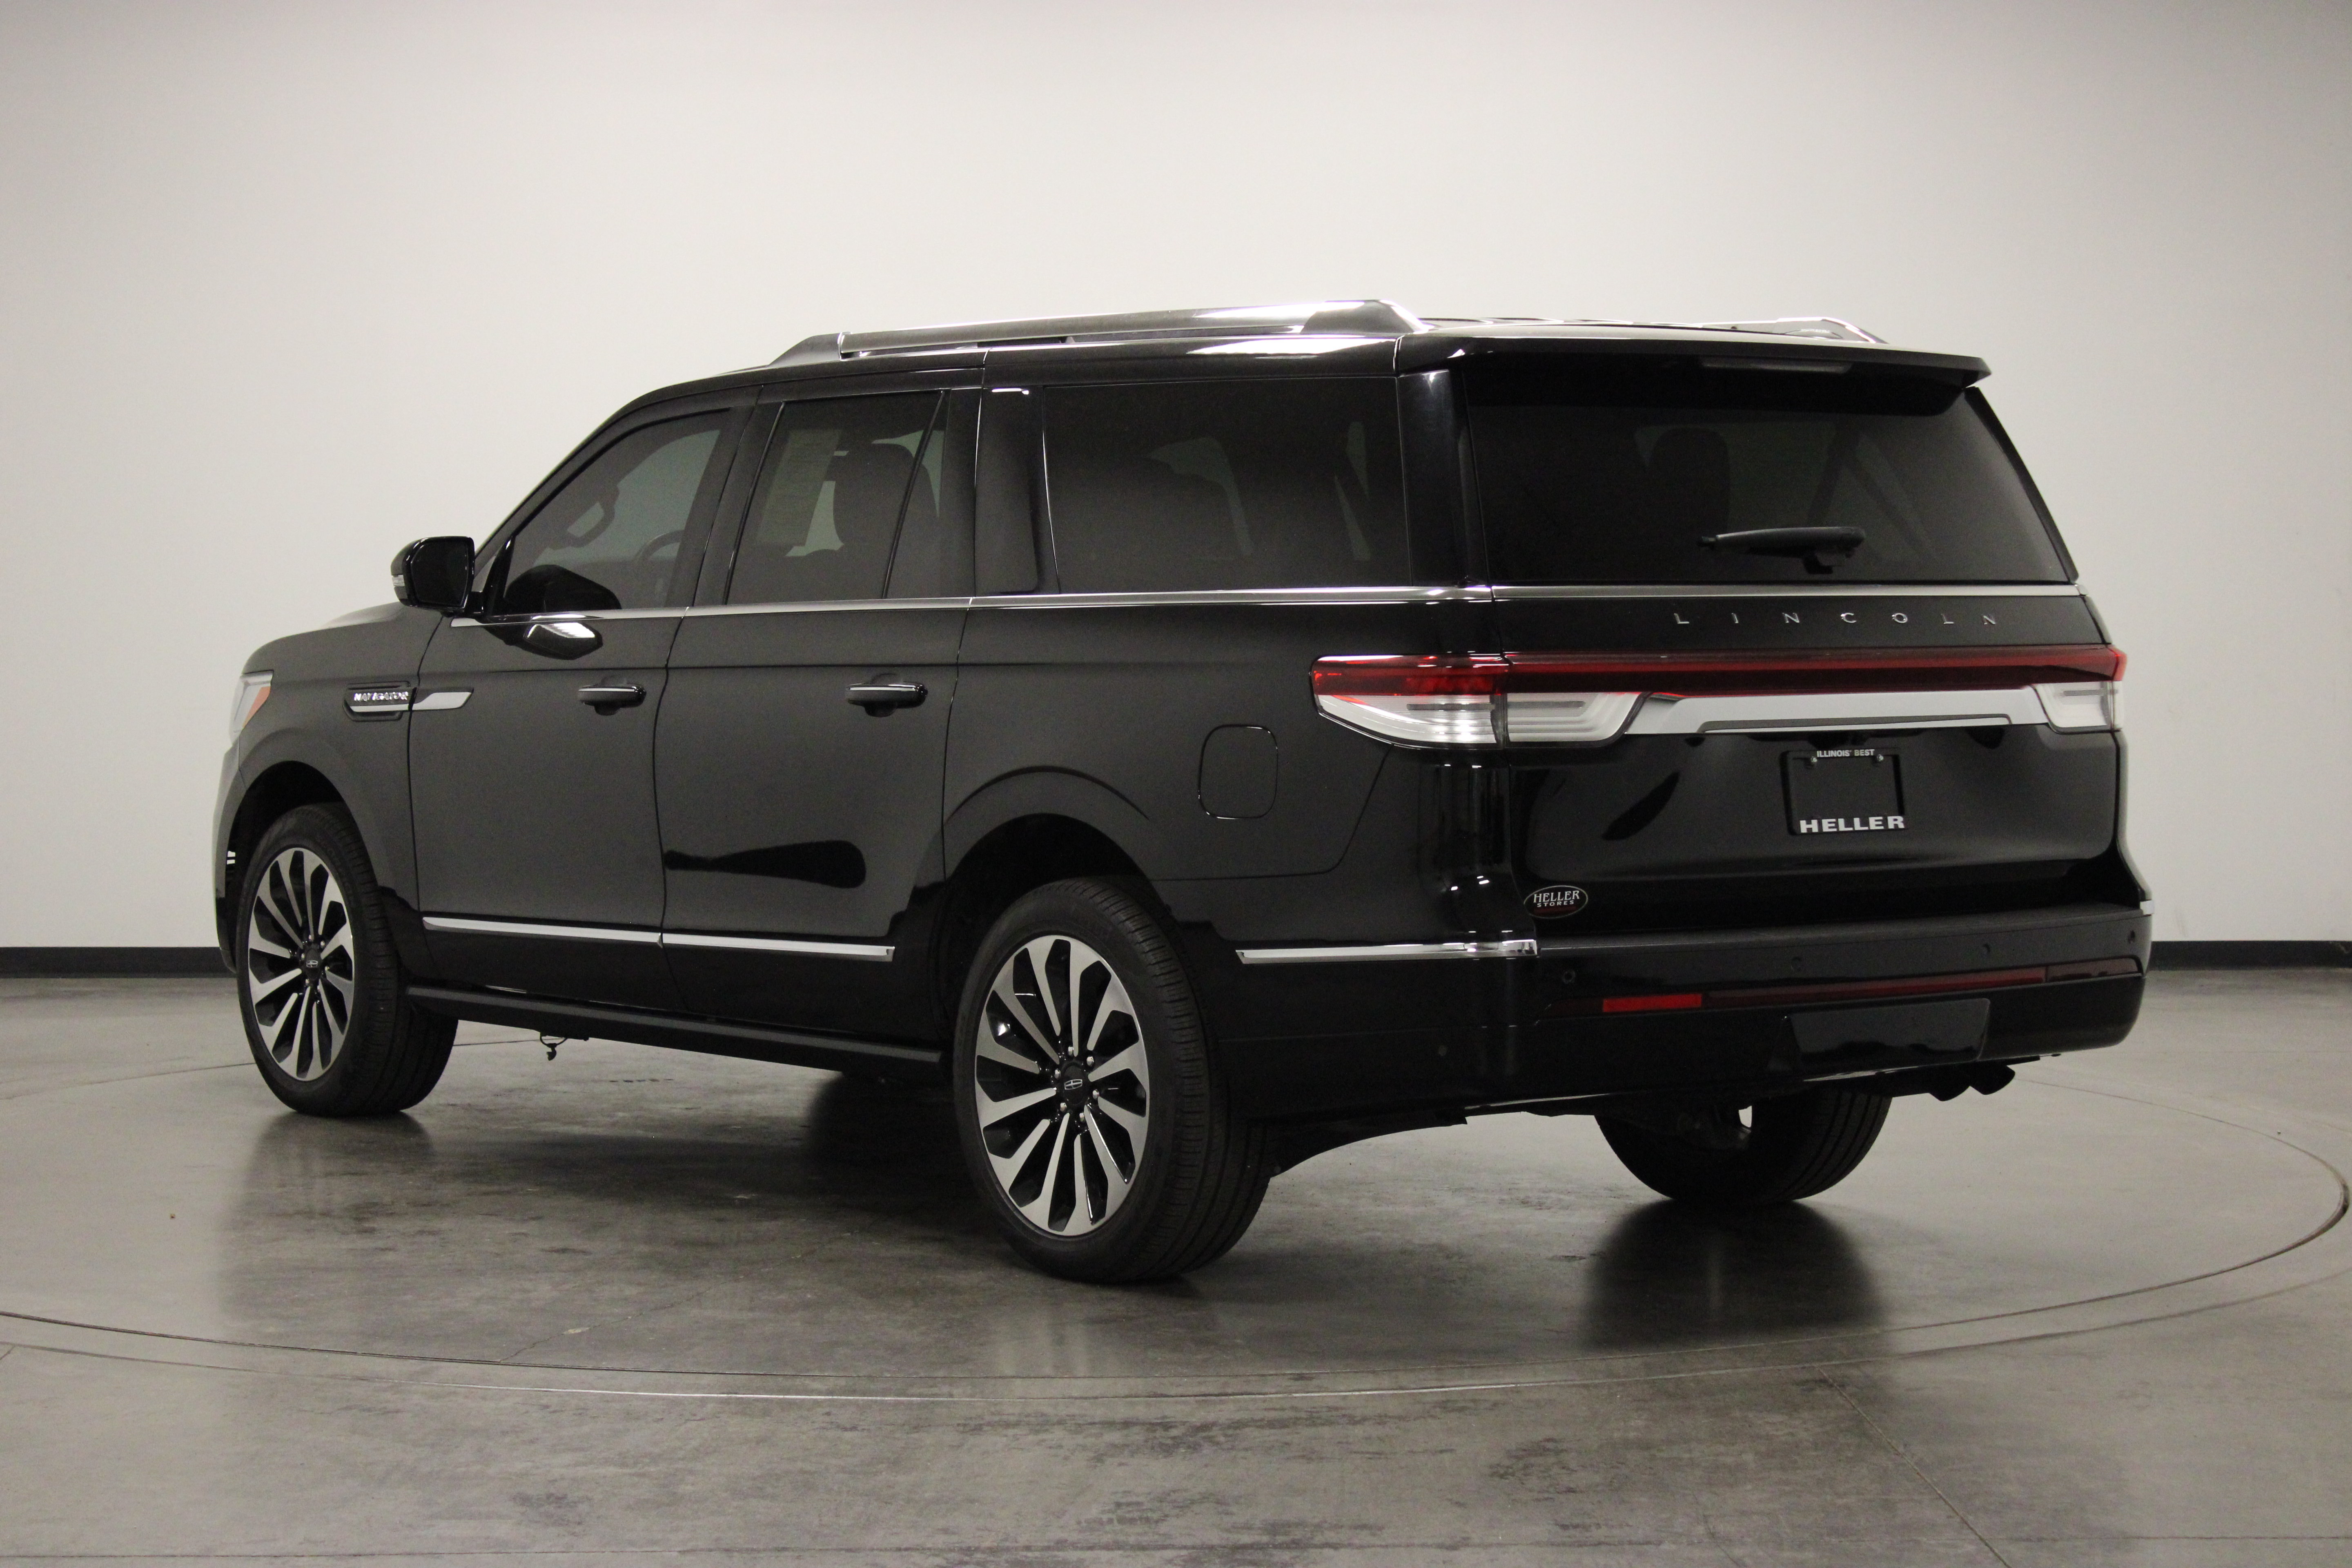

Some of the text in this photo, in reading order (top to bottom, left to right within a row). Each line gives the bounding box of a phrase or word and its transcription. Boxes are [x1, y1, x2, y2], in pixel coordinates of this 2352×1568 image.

[1674, 612, 1996, 625] LINCOLN
[354, 691, 409, 702] NAVIGATOR
[1800, 815, 1905, 833] HELLER
[1533, 890, 1580, 903] HELLER
